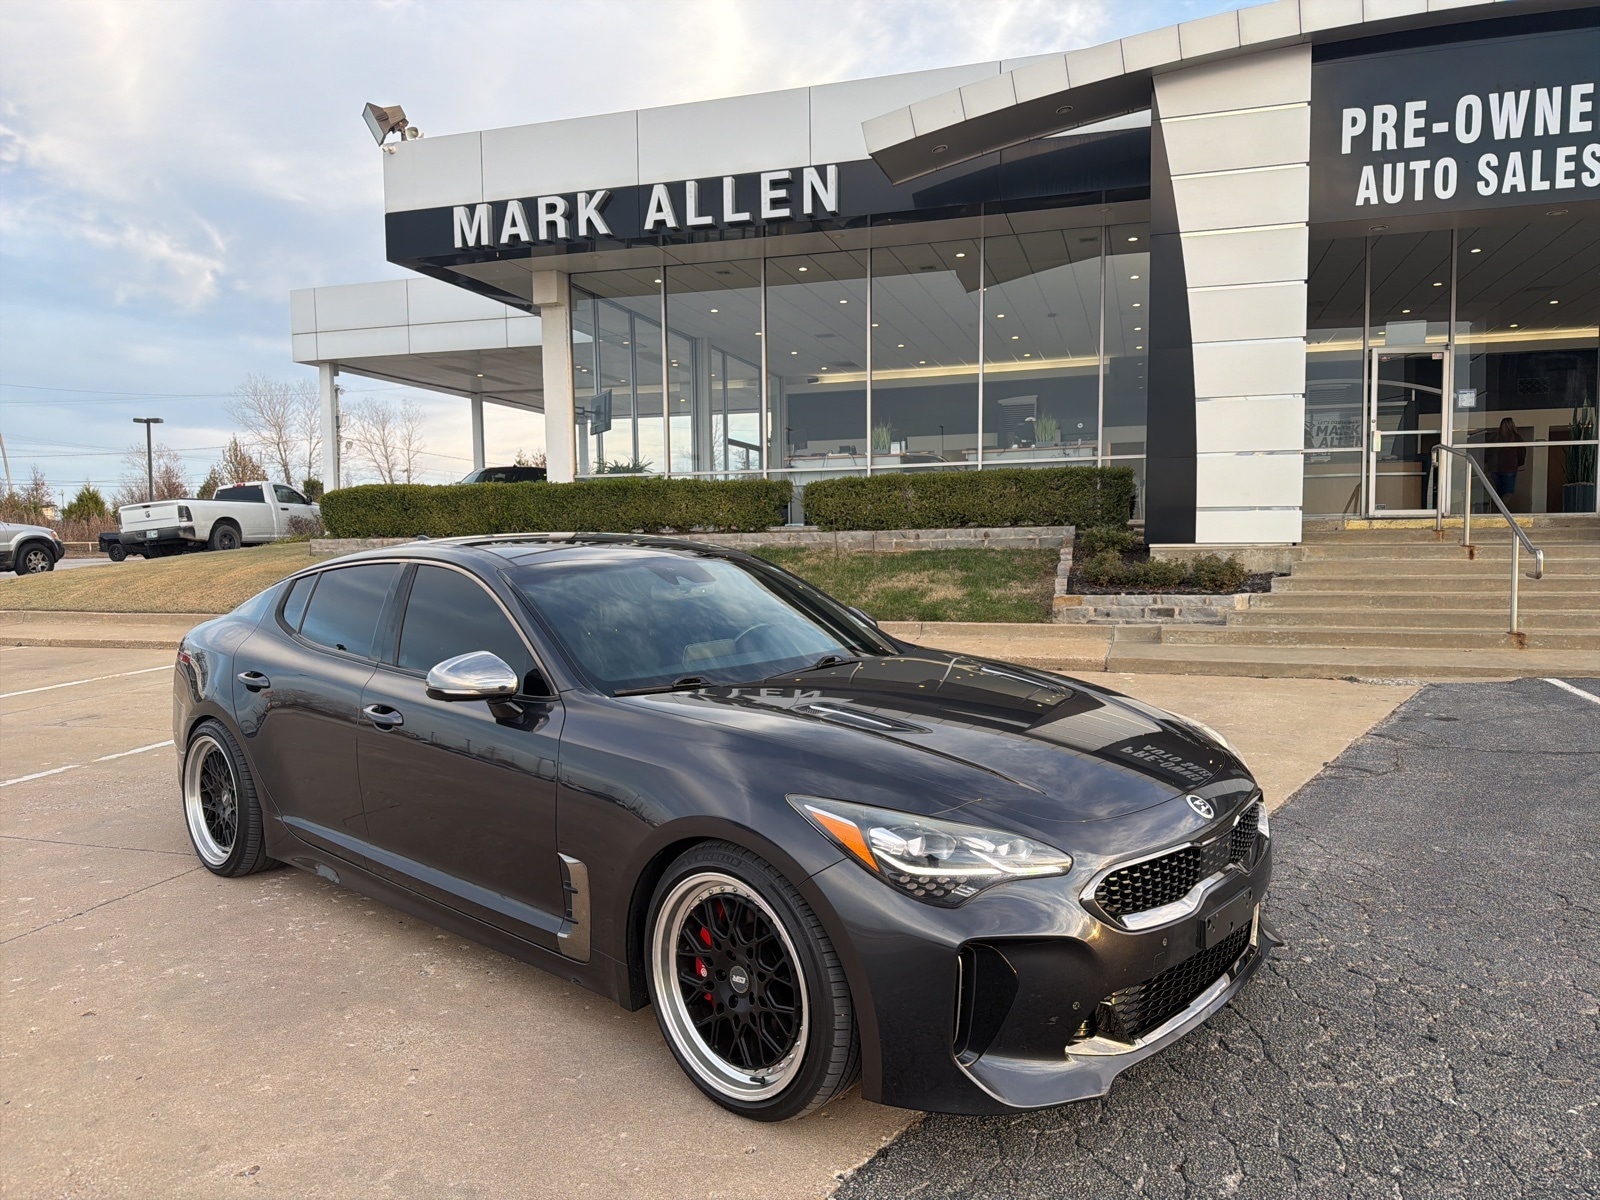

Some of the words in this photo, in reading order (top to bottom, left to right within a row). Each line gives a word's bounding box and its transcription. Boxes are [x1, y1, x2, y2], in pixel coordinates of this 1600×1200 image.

[1341, 83, 1600, 154] PRE-OWNE
[453, 190, 611, 248] MARK
[644, 164, 839, 231] ALLEN
[1355, 157, 1457, 206] AUTO
[1477, 143, 1600, 197] SALES
